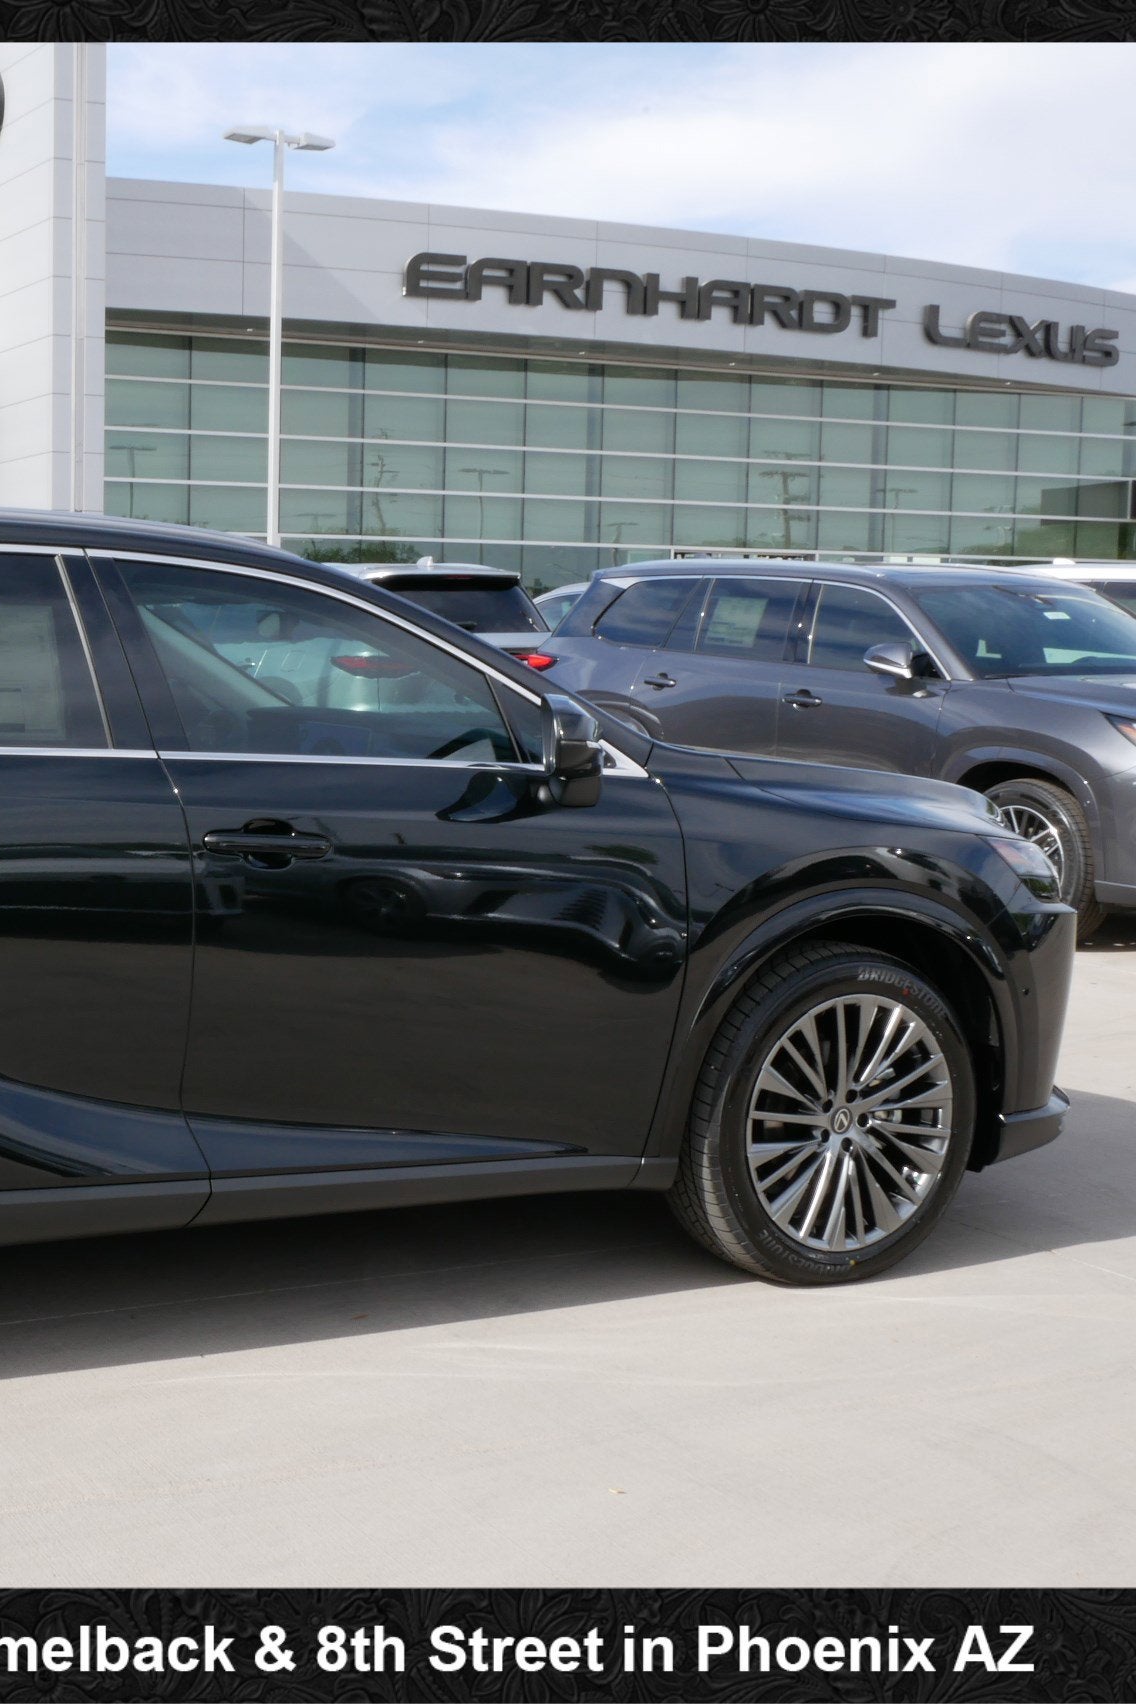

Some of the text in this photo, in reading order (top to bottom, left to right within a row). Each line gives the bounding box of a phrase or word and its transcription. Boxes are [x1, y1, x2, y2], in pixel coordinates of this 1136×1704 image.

[402, 252, 1119, 367] EARNHARDT LEXUS
[857, 966, 947, 1019] BRIDGESTONE
